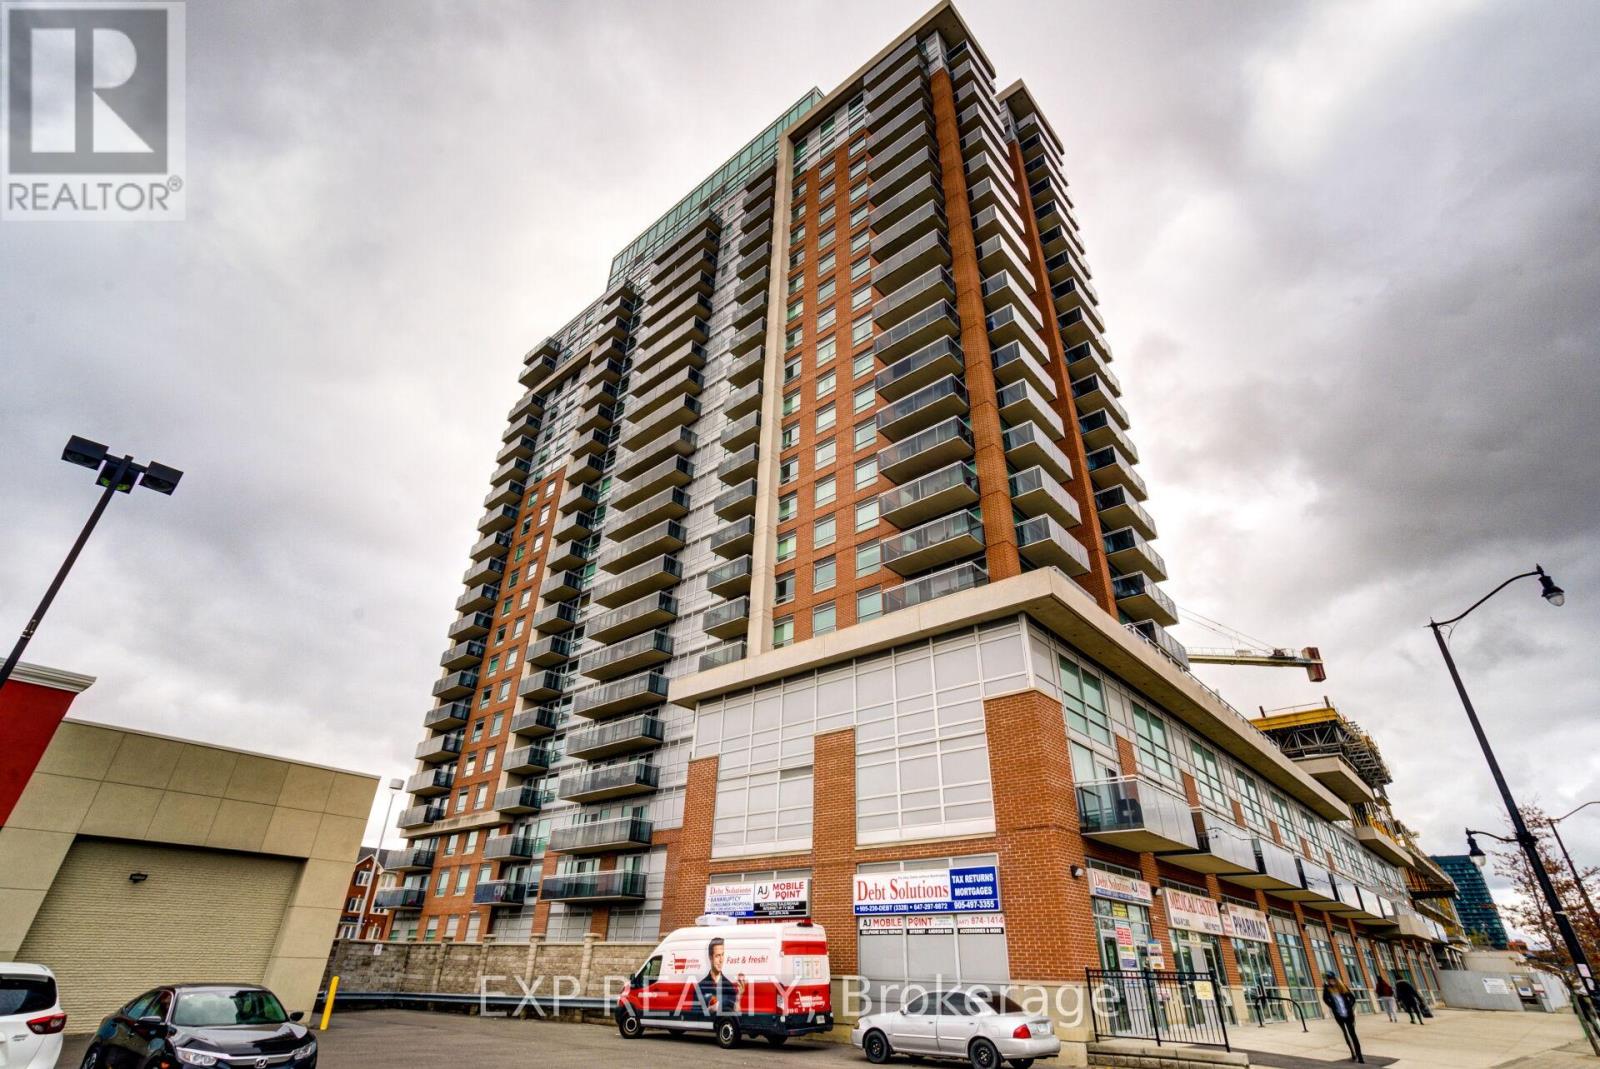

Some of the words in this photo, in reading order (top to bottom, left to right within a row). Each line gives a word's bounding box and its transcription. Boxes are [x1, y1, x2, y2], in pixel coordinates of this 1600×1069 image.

[952, 875, 963, 884] TAX
[965, 873, 994, 883] RETURNS
[758, 886, 768, 895] AJ
[772, 882, 804, 891] MOBILE
[857, 880, 886, 901] Debt
[889, 879, 949, 900] Solutions
[955, 886, 993, 896] MORTGAGES
[775, 890, 801, 900] POINT
[863, 919, 871, 927] AJ
[873, 918, 902, 927] MOBILE
[908, 917, 933, 926] POINT
[1232, 914, 1268, 940] PHARMACY
[748, 955, 769, 963] fresh!
